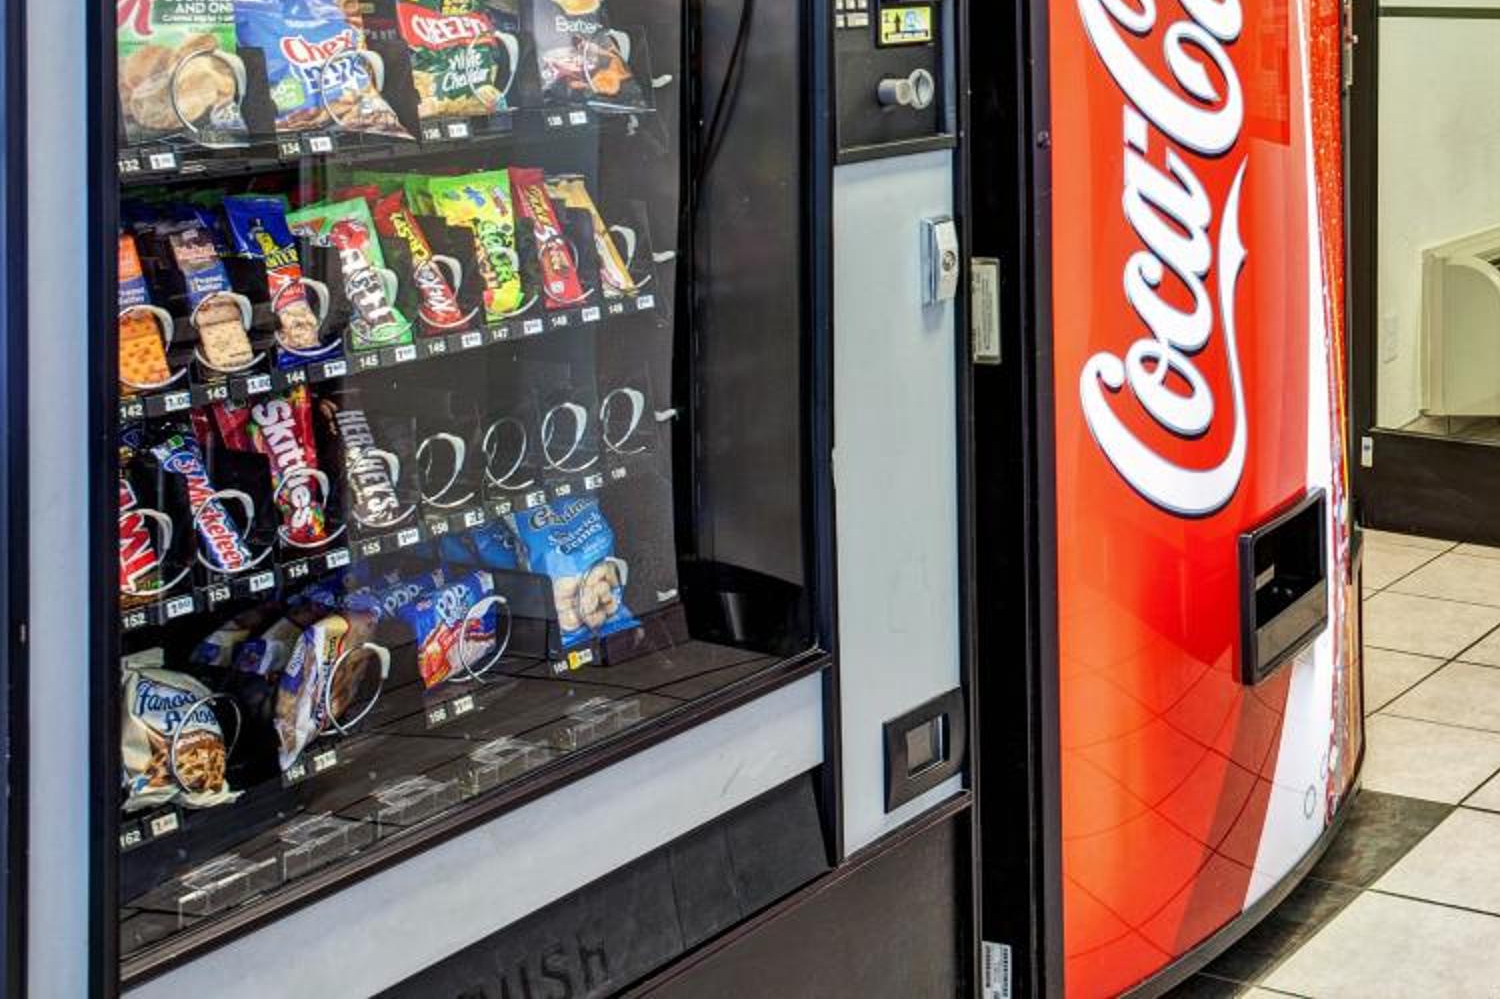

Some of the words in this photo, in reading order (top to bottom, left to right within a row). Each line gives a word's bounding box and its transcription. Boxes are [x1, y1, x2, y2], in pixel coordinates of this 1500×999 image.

[174, 2, 206, 14] AND
[280, 29, 354, 67] Chex
[281, 141, 300, 154] 134
[118, 158, 140, 172] 132
[206, 386, 228, 399] 143
[120, 404, 144, 419] 142
[289, 566, 309, 578] 154
[209, 587, 231, 601] 153
[123, 611, 148, 628] 152
[119, 830, 142, 849] 162
[457, 932, 611, 999] USH
